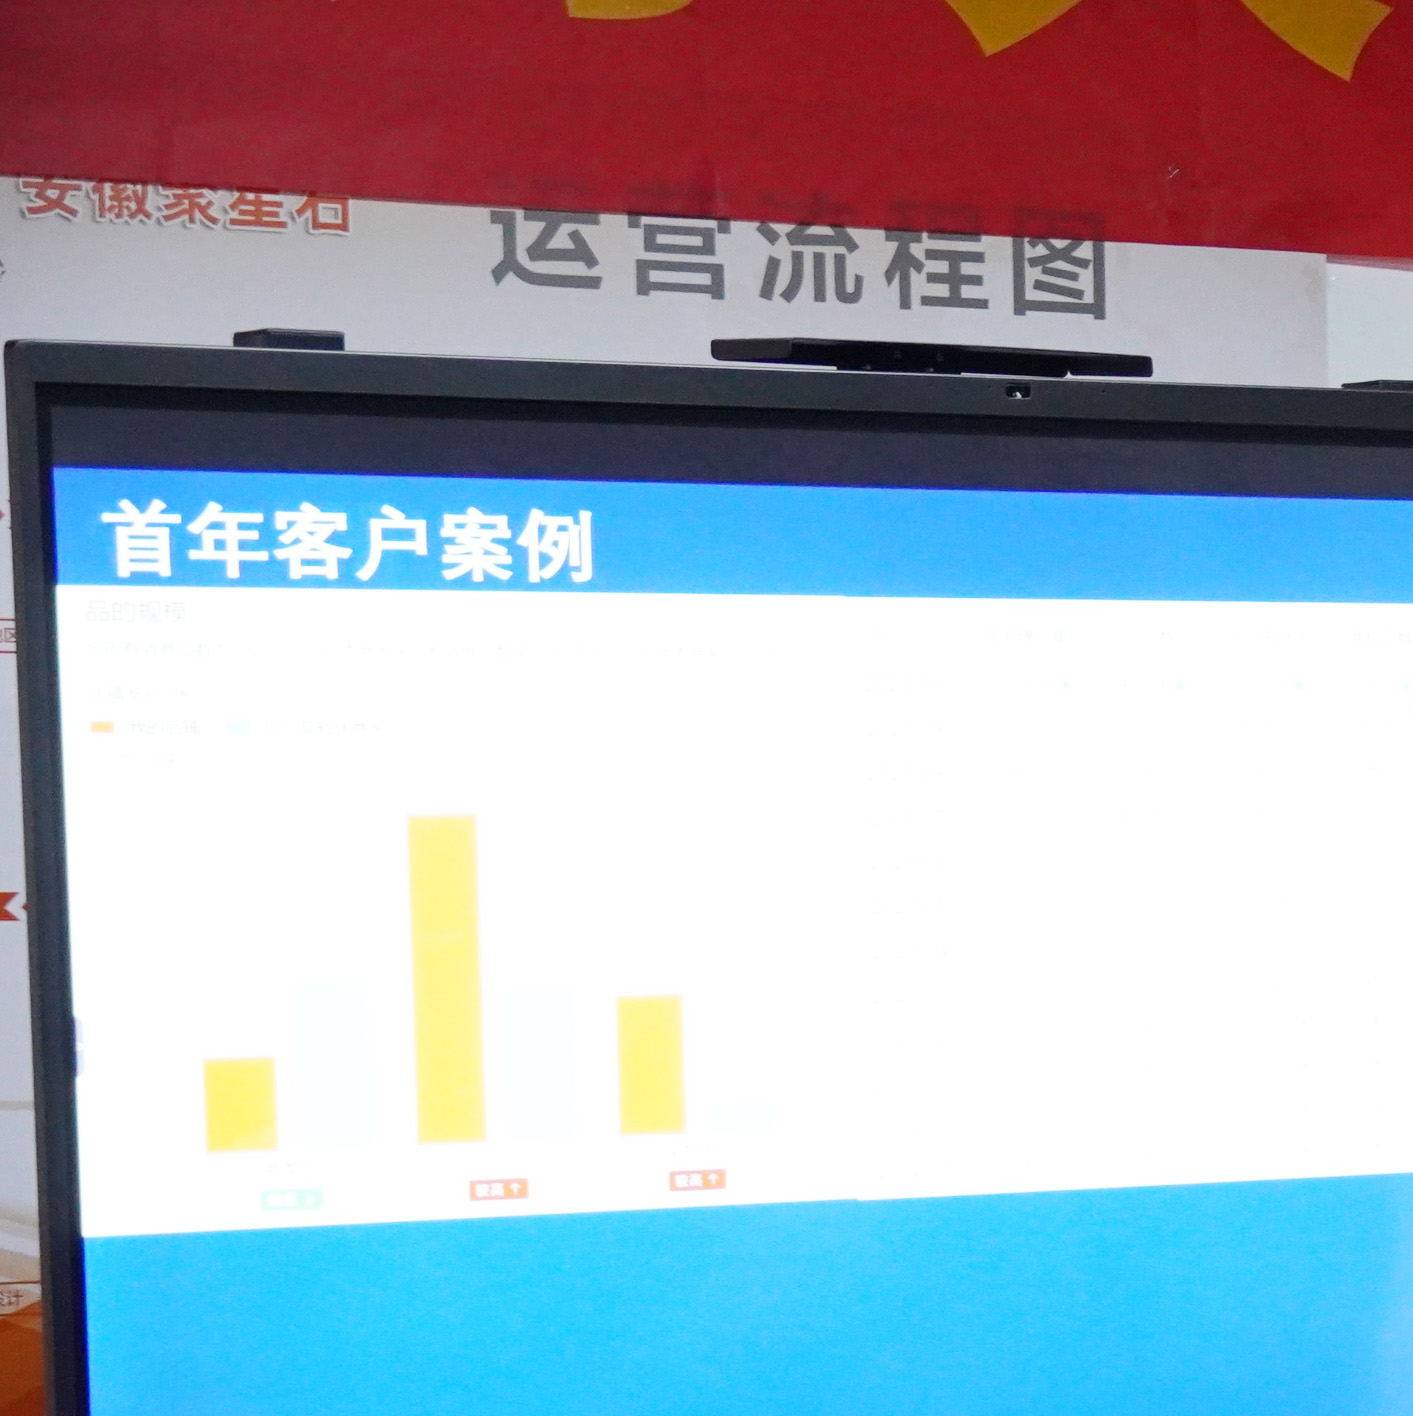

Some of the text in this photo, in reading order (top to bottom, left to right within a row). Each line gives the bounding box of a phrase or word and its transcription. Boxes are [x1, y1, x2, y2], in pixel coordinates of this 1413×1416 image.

[489, 208, 1107, 321] 运营流程图
[101, 498, 593, 583] 首年客户案例
